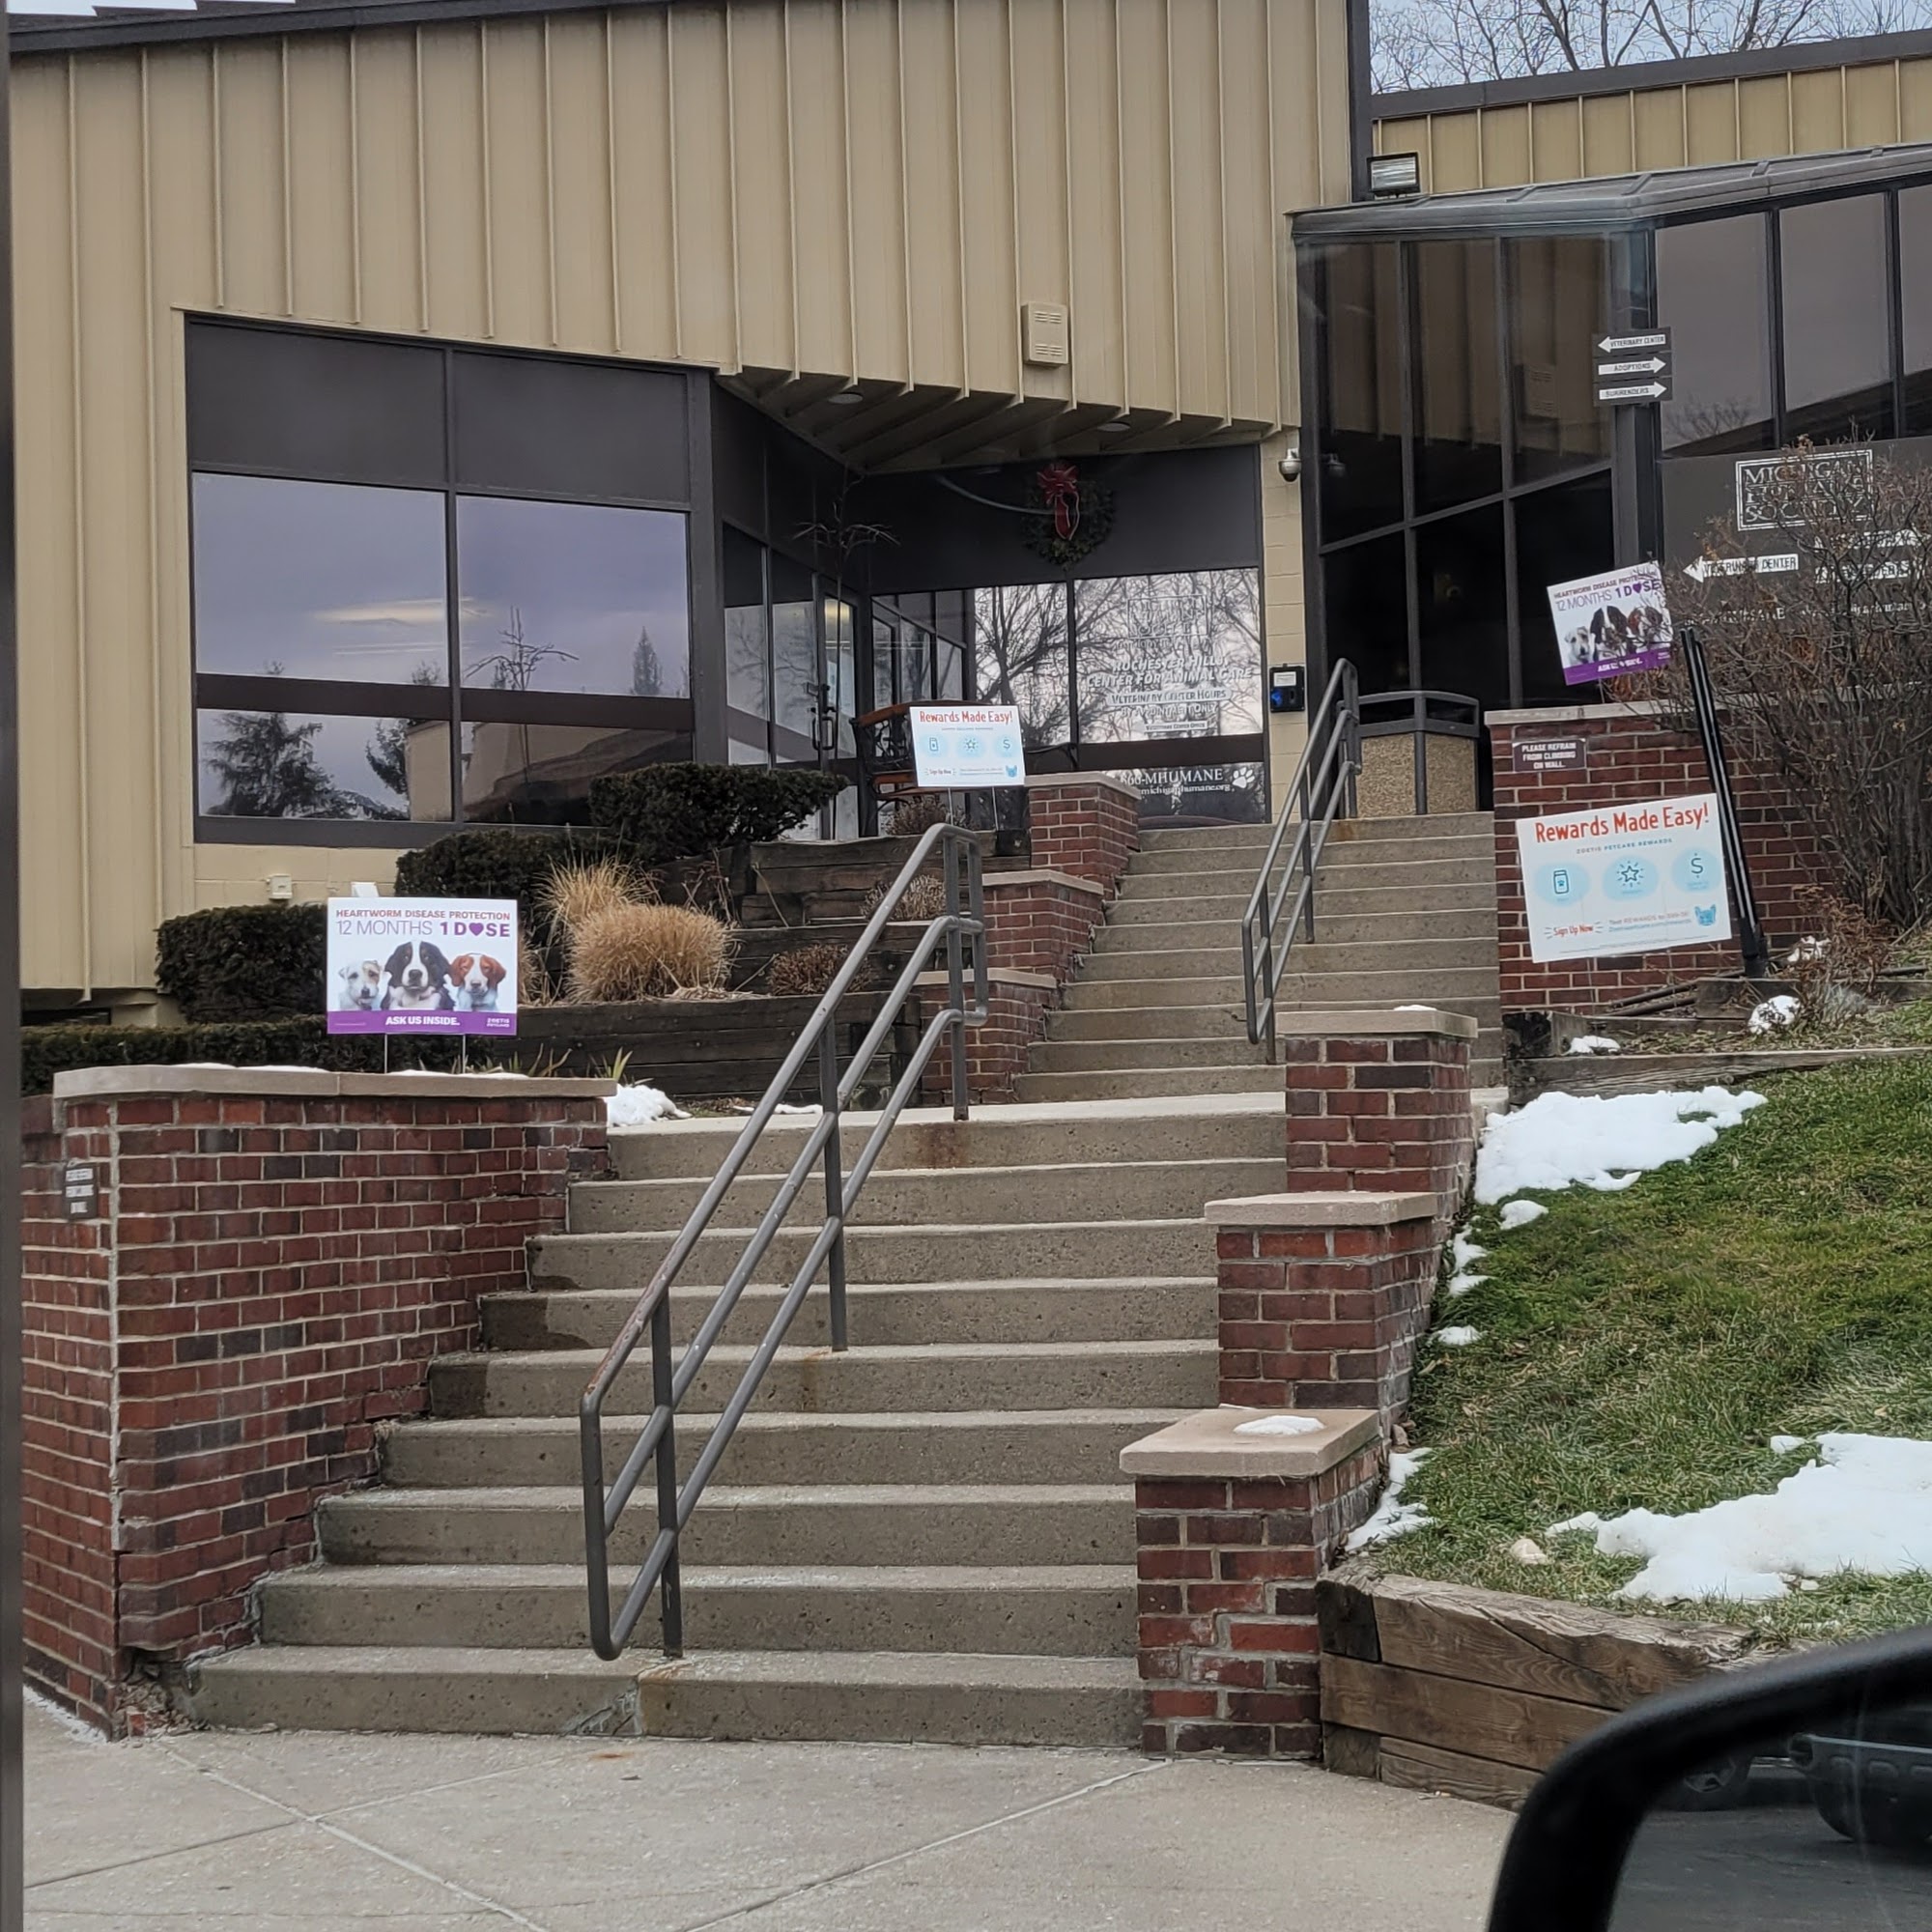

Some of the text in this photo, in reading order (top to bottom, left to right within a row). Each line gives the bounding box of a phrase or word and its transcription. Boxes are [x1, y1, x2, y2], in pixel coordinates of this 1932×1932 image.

[1610, 338, 1642, 348] VETERINARY
[1614, 362, 1651, 372] ADOPTIONS
[1605, 387, 1649, 398] SURRENDERS
[1762, 557, 1796, 570] CENTER
[1553, 585, 1592, 599] HEARTWORM
[1593, 580, 1618, 590] DISEASE
[1556, 600, 1566, 611] 12
[1567, 589, 1612, 610] MONTHS
[1615, 587, 1621, 599] 1
[1113, 658, 1188, 673] ROCHESTER
[1087, 667, 1253, 689] CENTER FOR ANIMAL CARE
[1111, 693, 1163, 705] VETERINARY
[1198, 690, 1227, 699] HOURS
[1194, 702, 1217, 714] ONLY
[920, 710, 1013, 724] Rewards Made Easy!
[1521, 742, 1577, 753] PLEASE REFRAIN
[1544, 751, 1576, 760] CLIMBING
[1535, 802, 1710, 843] Rewards Made Easy!
[1576, 838, 1673, 855] ZOETIS PETCARE REWARDS
[335, 909, 511, 921] HEARTWORM DISEASE PROTECTION
[336, 920, 353, 935] 12
[356, 920, 433, 935] MONTHS
[440, 922, 448, 935] 1
[1553, 923, 1594, 938] Sign Up Now
[385, 1015, 461, 1026] ASK US INSIDE.
